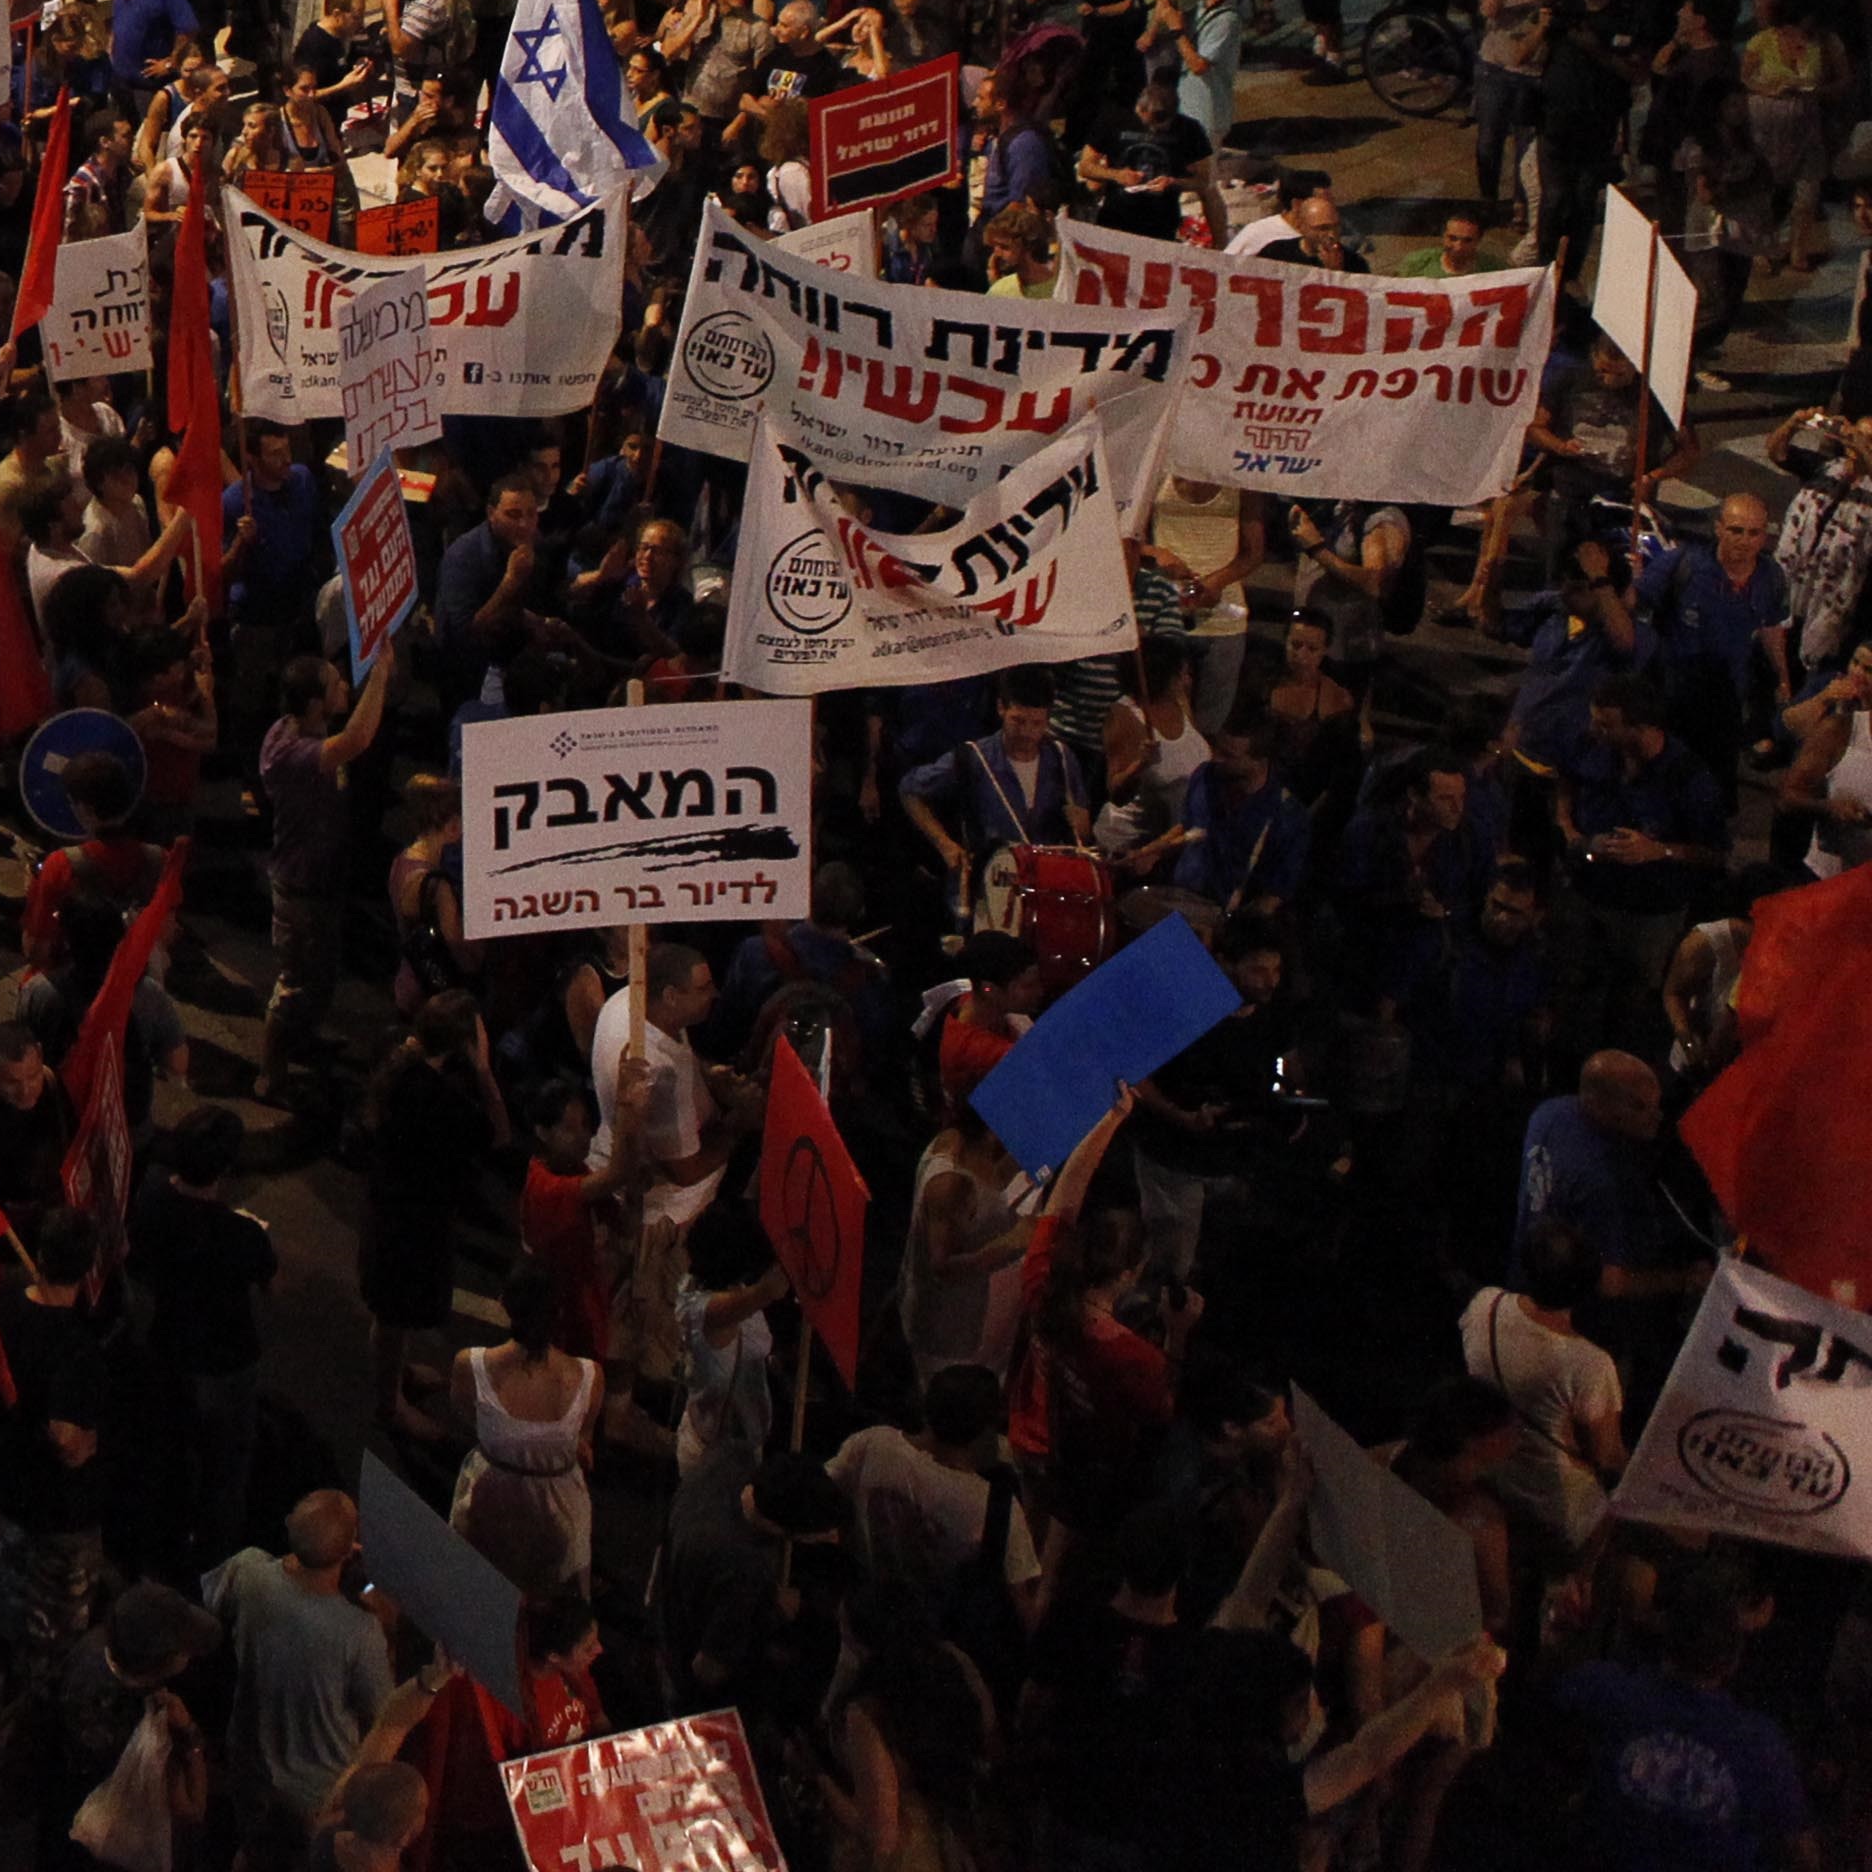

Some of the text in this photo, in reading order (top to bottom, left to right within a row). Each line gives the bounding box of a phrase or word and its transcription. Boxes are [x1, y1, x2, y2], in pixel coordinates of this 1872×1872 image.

[835, 120, 939, 161] דרור ישראל
[704, 228, 898, 348] רווחה
[688, 344, 767, 380] עד כאן!
[703, 329, 767, 364] הגזמתם
[924, 315, 1176, 386] מדינת
[795, 336, 1074, 439] עכשיו!
[1234, 360, 1528, 409] שורפת את
[791, 409, 847, 438] ישראל
[1234, 401, 1323, 425] תנועת
[861, 434, 905, 454] דרור
[1244, 425, 1311, 451] דרור
[1233, 450, 1322, 474] ישראל
[773, 576, 849, 599] עד כאן!
[491, 762, 779, 852] המאבק
[493, 871, 781, 924] לדיור בר השגה
